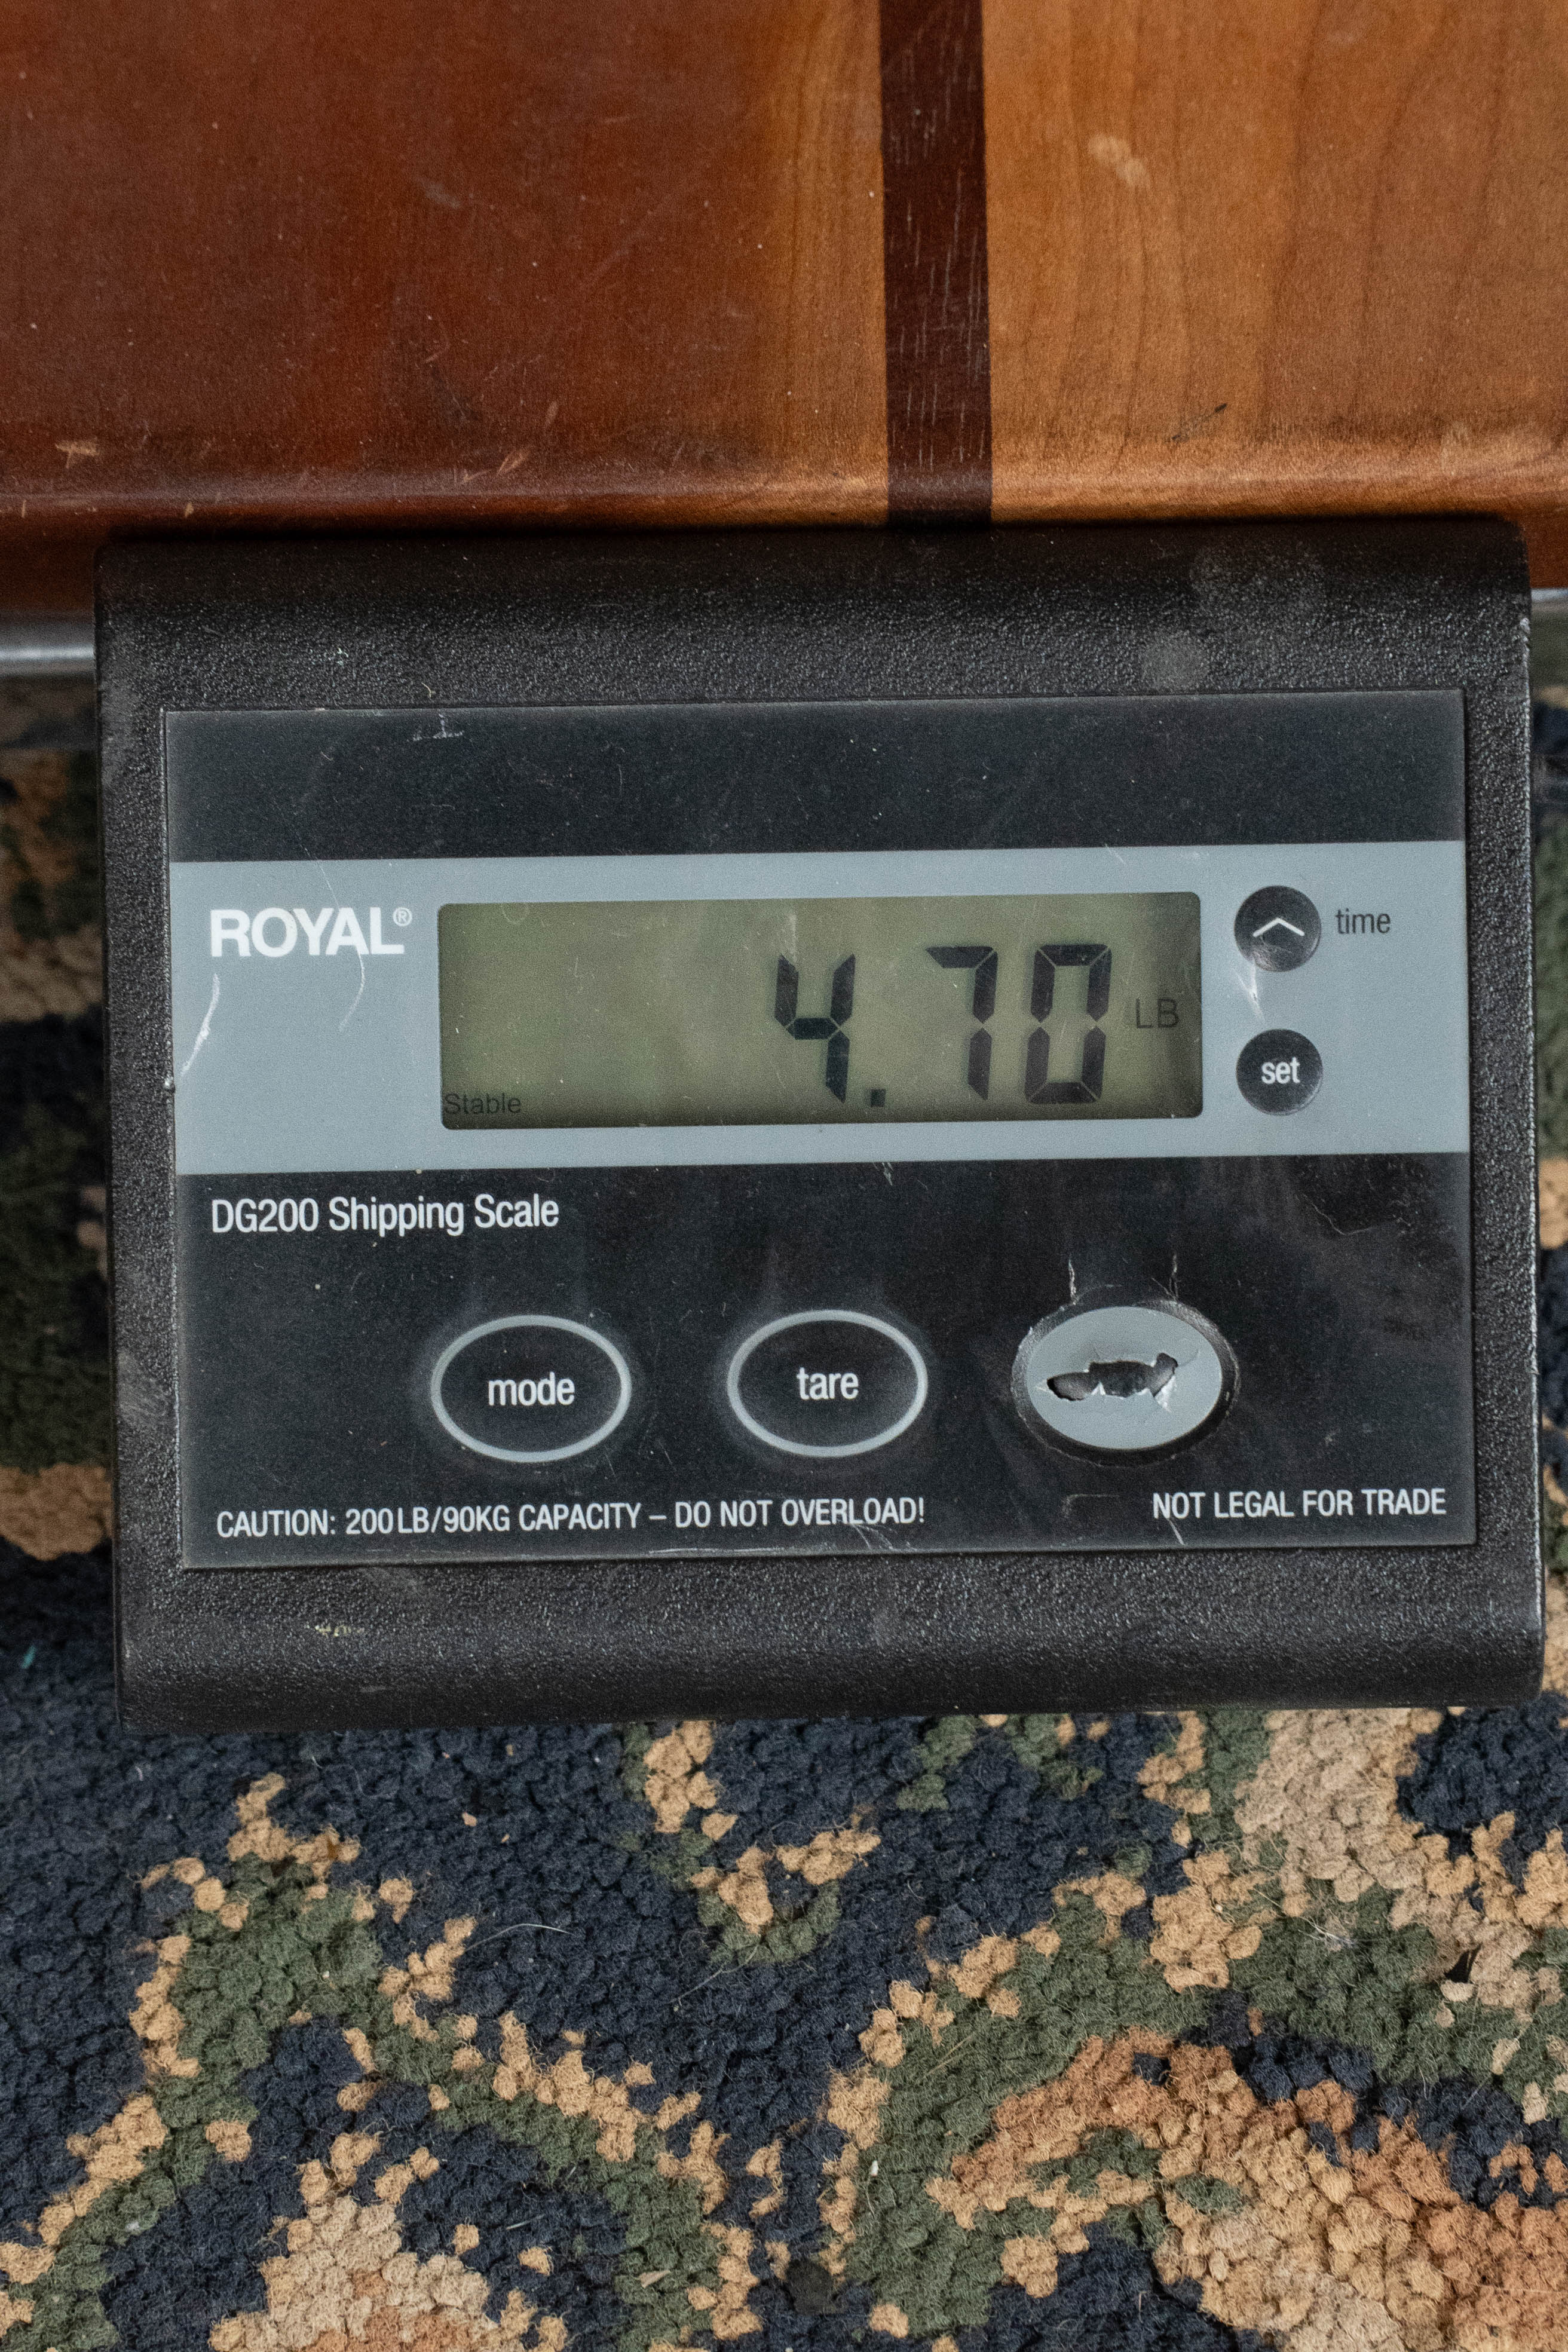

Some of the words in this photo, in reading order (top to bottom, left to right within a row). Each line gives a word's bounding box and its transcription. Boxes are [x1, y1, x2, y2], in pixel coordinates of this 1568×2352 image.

[1335, 908, 1391, 934] time
[774, 943, 1113, 1108] 4.70
[1135, 999, 1180, 1031] LB
[1261, 1058, 1301, 1086] set
[444, 1093, 521, 1115] Stable
[212, 1198, 318, 1233] DG200
[329, 1195, 465, 1236] Shipping
[474, 1193, 559, 1228] Scale
[488, 1371, 575, 1407] mode
[797, 1367, 859, 1400] tare
[217, 1510, 336, 1539] CAUTION:
[518, 1503, 642, 1532] CAPACITY
[675, 1500, 711, 1529] DO
[720, 1499, 773, 1527] NOT
[780, 1497, 924, 1526] OVERLOAD!
[1153, 1492, 1205, 1519] NOT
[1214, 1490, 1294, 1518] LEGAL
[1303, 1489, 1354, 1517] FOR
[1360, 1487, 1447, 1515] TRADE
